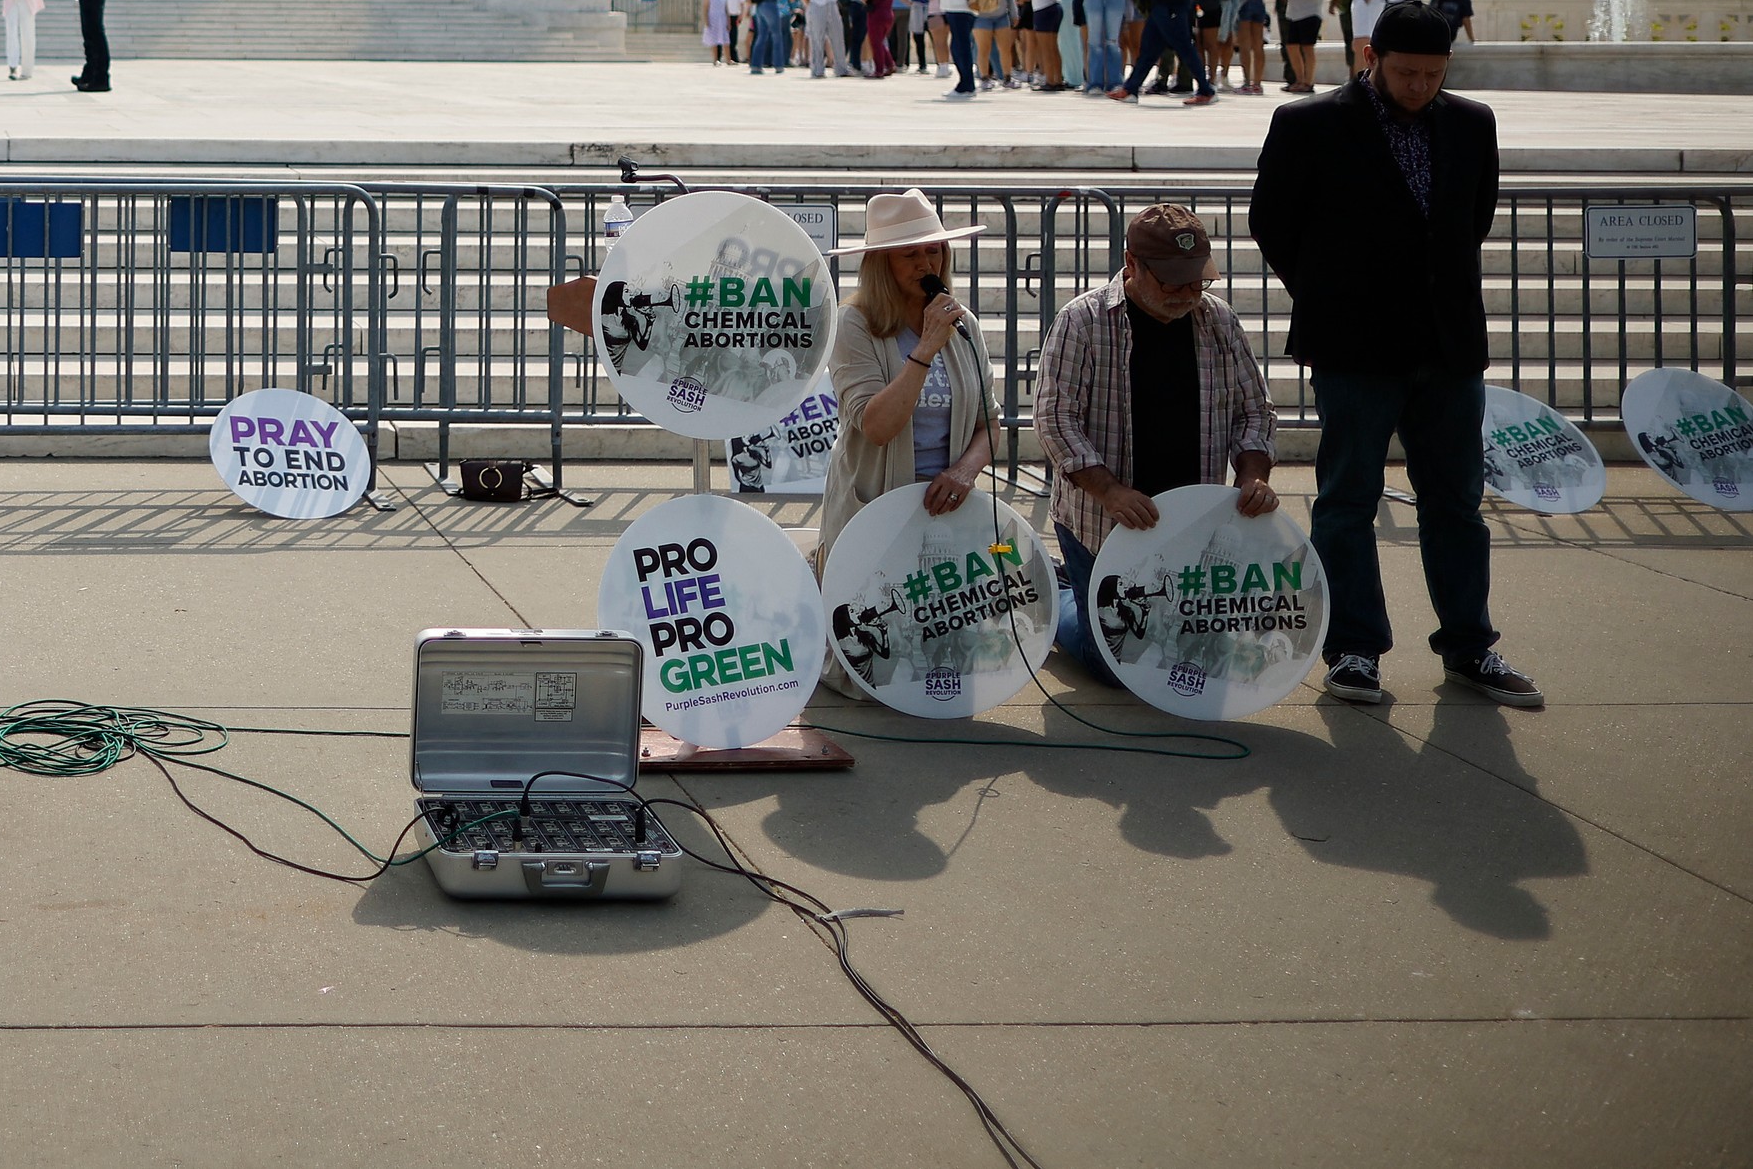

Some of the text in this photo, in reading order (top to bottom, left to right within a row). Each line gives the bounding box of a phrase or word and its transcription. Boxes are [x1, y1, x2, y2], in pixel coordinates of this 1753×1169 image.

[787, 213, 824, 224] OSED
[1600, 215, 1684, 227] AREA CLOSED
[684, 275, 811, 308] #BAN
[684, 311, 812, 329] CHEMICAL
[684, 332, 813, 349] ABORTIONS
[669, 385, 705, 406] SASH
[673, 378, 708, 396] #PURPLE
[666, 395, 702, 412] REVOLUTION
[780, 391, 838, 427] #EN
[229, 415, 339, 449] PRAY
[788, 417, 840, 444] ABORT
[1491, 415, 1562, 448] #BAN
[1676, 406, 1749, 437] #BAN
[233, 446, 346, 472] TO END
[1507, 433, 1573, 459] CHEMICAL
[1517, 442, 1582, 469] ABORTIONS
[238, 470, 349, 491] ABORTION
[1713, 484, 1739, 492] SASH
[633, 537, 718, 583] PRO
[902, 537, 1024, 605] #BAN
[1177, 561, 1303, 597] #BAN
[641, 573, 726, 620] LIFE
[913, 570, 1033, 624] CHEMICAL
[1179, 594, 1305, 617] CHEMICAL
[921, 588, 1039, 643] ABORTIONS
[1180, 614, 1308, 635] ABORTIONS
[649, 611, 735, 658] PRO
[660, 638, 795, 694] GREEN
[1172, 664, 1208, 680] #PURPLE
[926, 679, 961, 690] SASH
[1167, 681, 1203, 695] REVOLUTION
[1169, 671, 1206, 690] SASH
[665, 679, 800, 712] PurpleSashRevolution.com
